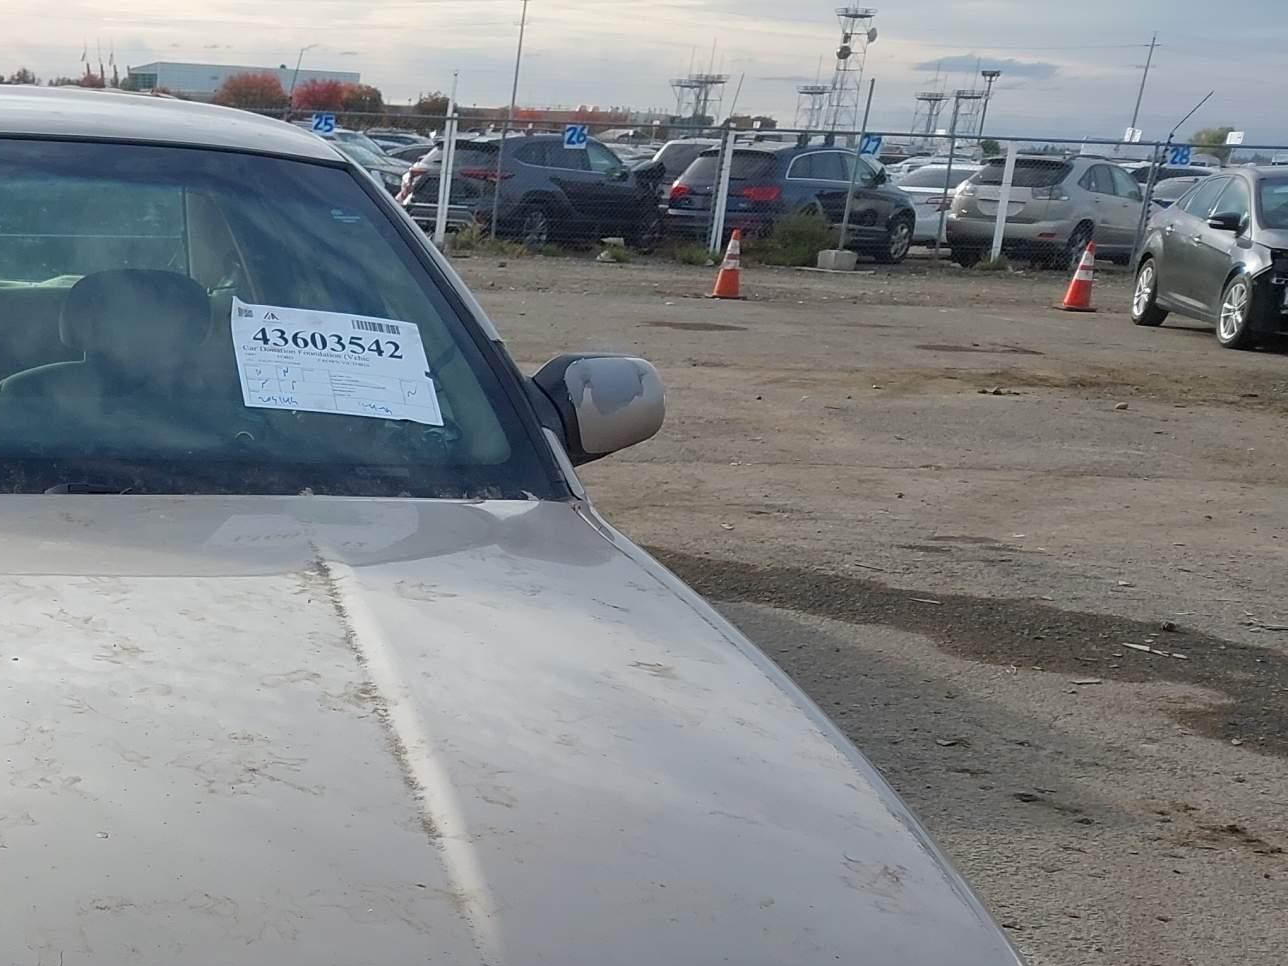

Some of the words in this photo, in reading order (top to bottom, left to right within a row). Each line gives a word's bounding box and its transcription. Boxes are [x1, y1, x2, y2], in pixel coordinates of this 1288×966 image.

[312, 113, 335, 133] 25
[566, 126, 587, 145] 26
[860, 135, 882, 155] 27
[1168, 146, 1192, 165] 28
[252, 326, 404, 359] 43603542
